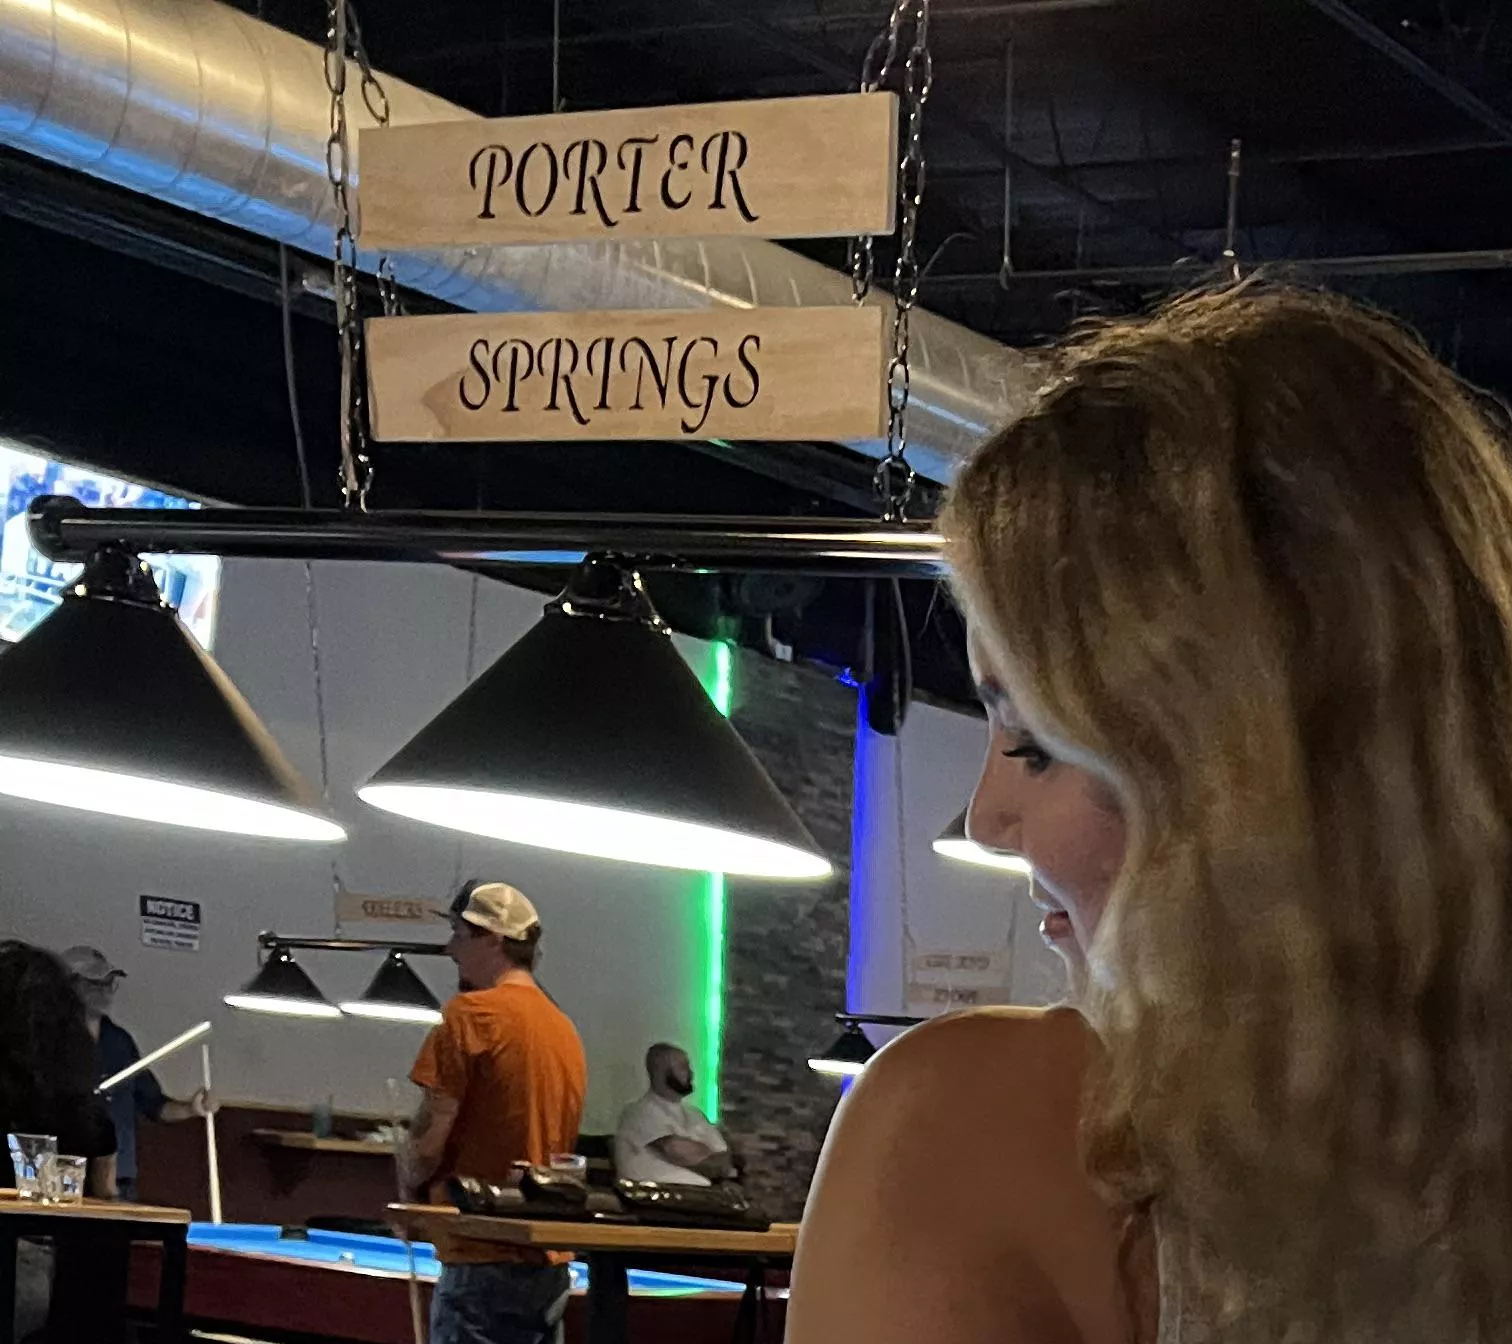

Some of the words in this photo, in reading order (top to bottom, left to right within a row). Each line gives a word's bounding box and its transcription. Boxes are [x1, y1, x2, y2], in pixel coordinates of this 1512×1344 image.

[469, 130, 760, 227] PORTER
[459, 335, 761, 433] SPRINGS
[146, 899, 195, 920] NOTICE
